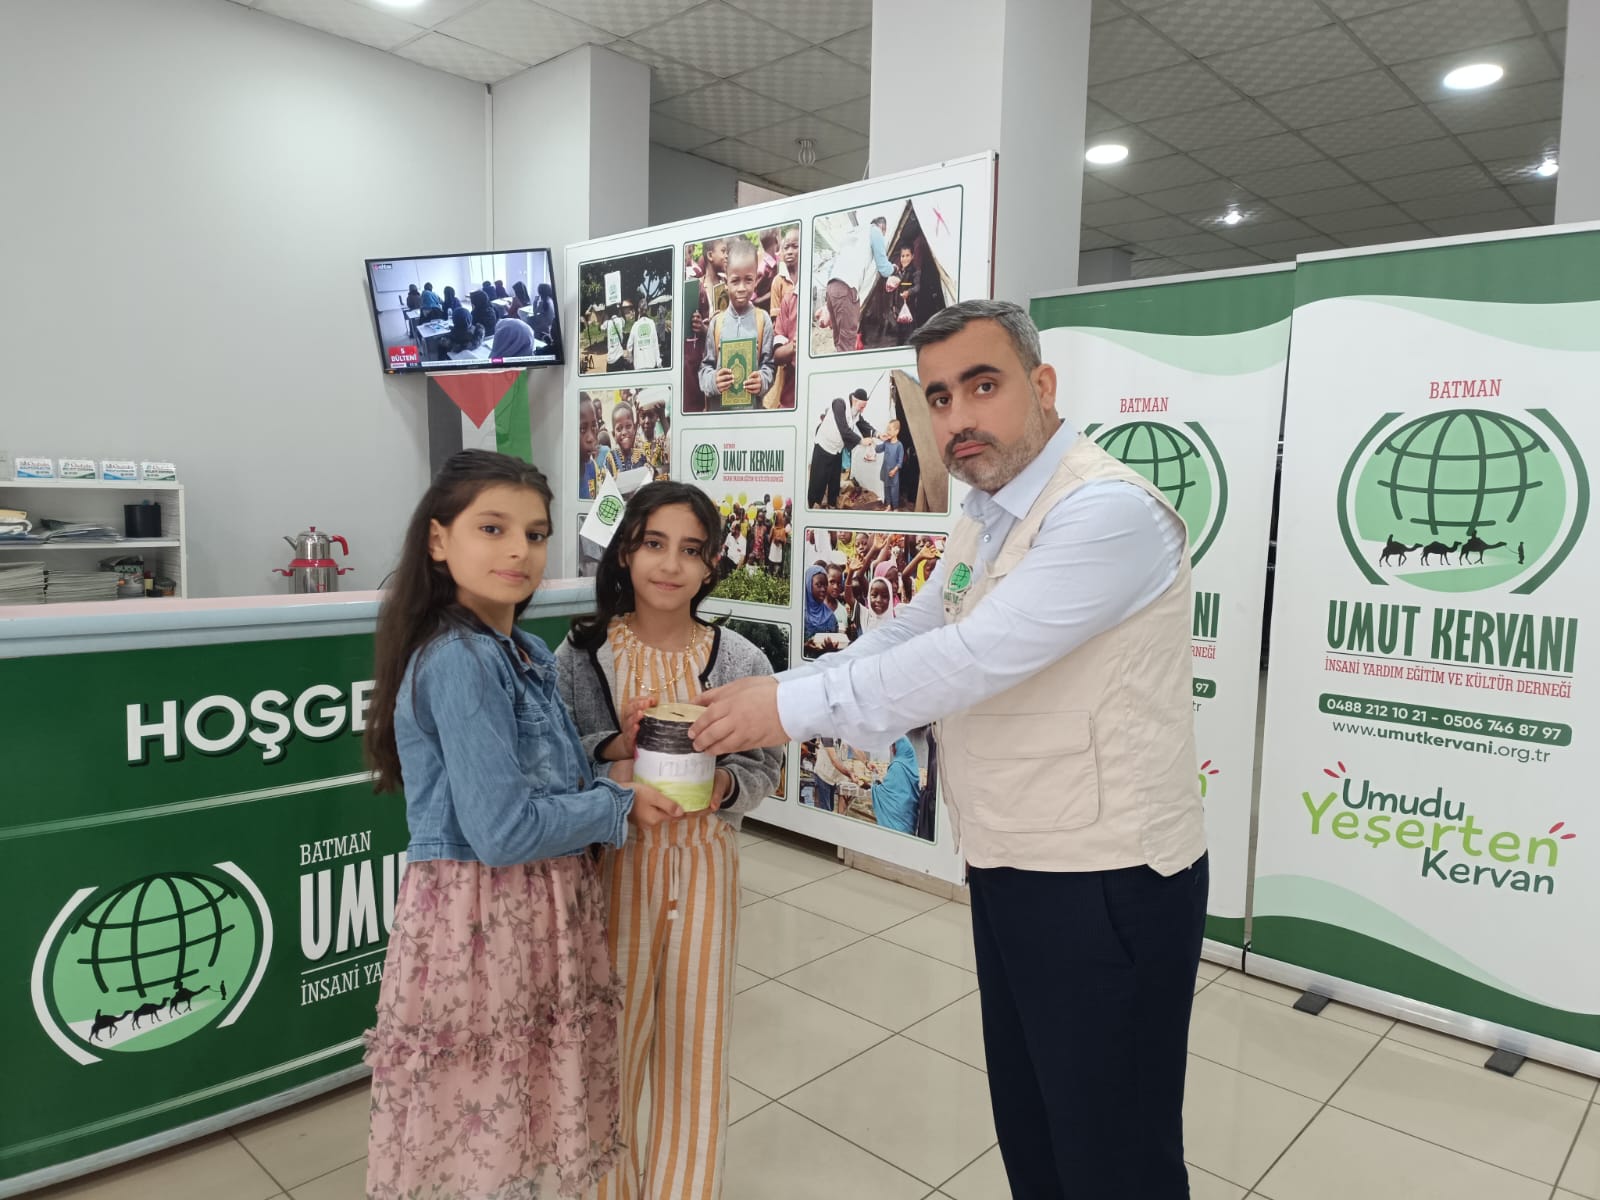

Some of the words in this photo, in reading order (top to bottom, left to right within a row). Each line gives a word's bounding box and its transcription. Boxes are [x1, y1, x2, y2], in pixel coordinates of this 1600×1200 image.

[1120, 397, 1169, 413] BATMAN
[1429, 379, 1503, 400] BATMAN
[723, 450, 747, 472] UMUT
[749, 450, 784, 472] KERVANI
[1193, 591, 1221, 638] NI
[1191, 644, 1216, 660] RNEĞİ
[1327, 600, 1421, 657] UMUT
[1430, 607, 1579, 673] KERVANI
[1195, 682, 1209, 694] 97
[1325, 656, 1361, 674] İNSANİ
[1363, 662, 1404, 679] YARDIM
[1406, 665, 1445, 684] EĞİTİM
[1448, 672, 1463, 686] VE
[1465, 672, 1514, 692] KÜLTÜR
[1516, 680, 1572, 698] DERNEĞİ
[126, 680, 377, 762] HOŞGE
[1327, 698, 1362, 713] 0488
[1365, 703, 1388, 717] 212
[1392, 707, 1409, 719] 10
[1411, 709, 1427, 722] 21
[1443, 714, 1483, 730] 0506
[1487, 719, 1514, 734] 746
[1518, 724, 1538, 737] 87
[1542, 727, 1562, 740] 97
[1332, 721, 1551, 763] www.umutkervani.org.tr
[1342, 778, 1465, 822] Umudu
[299, 830, 372, 867] BATMAN
[1301, 791, 1559, 867] Yeşerten
[1421, 847, 1555, 895] Kervan
[301, 963, 360, 1007] İNSANİ
